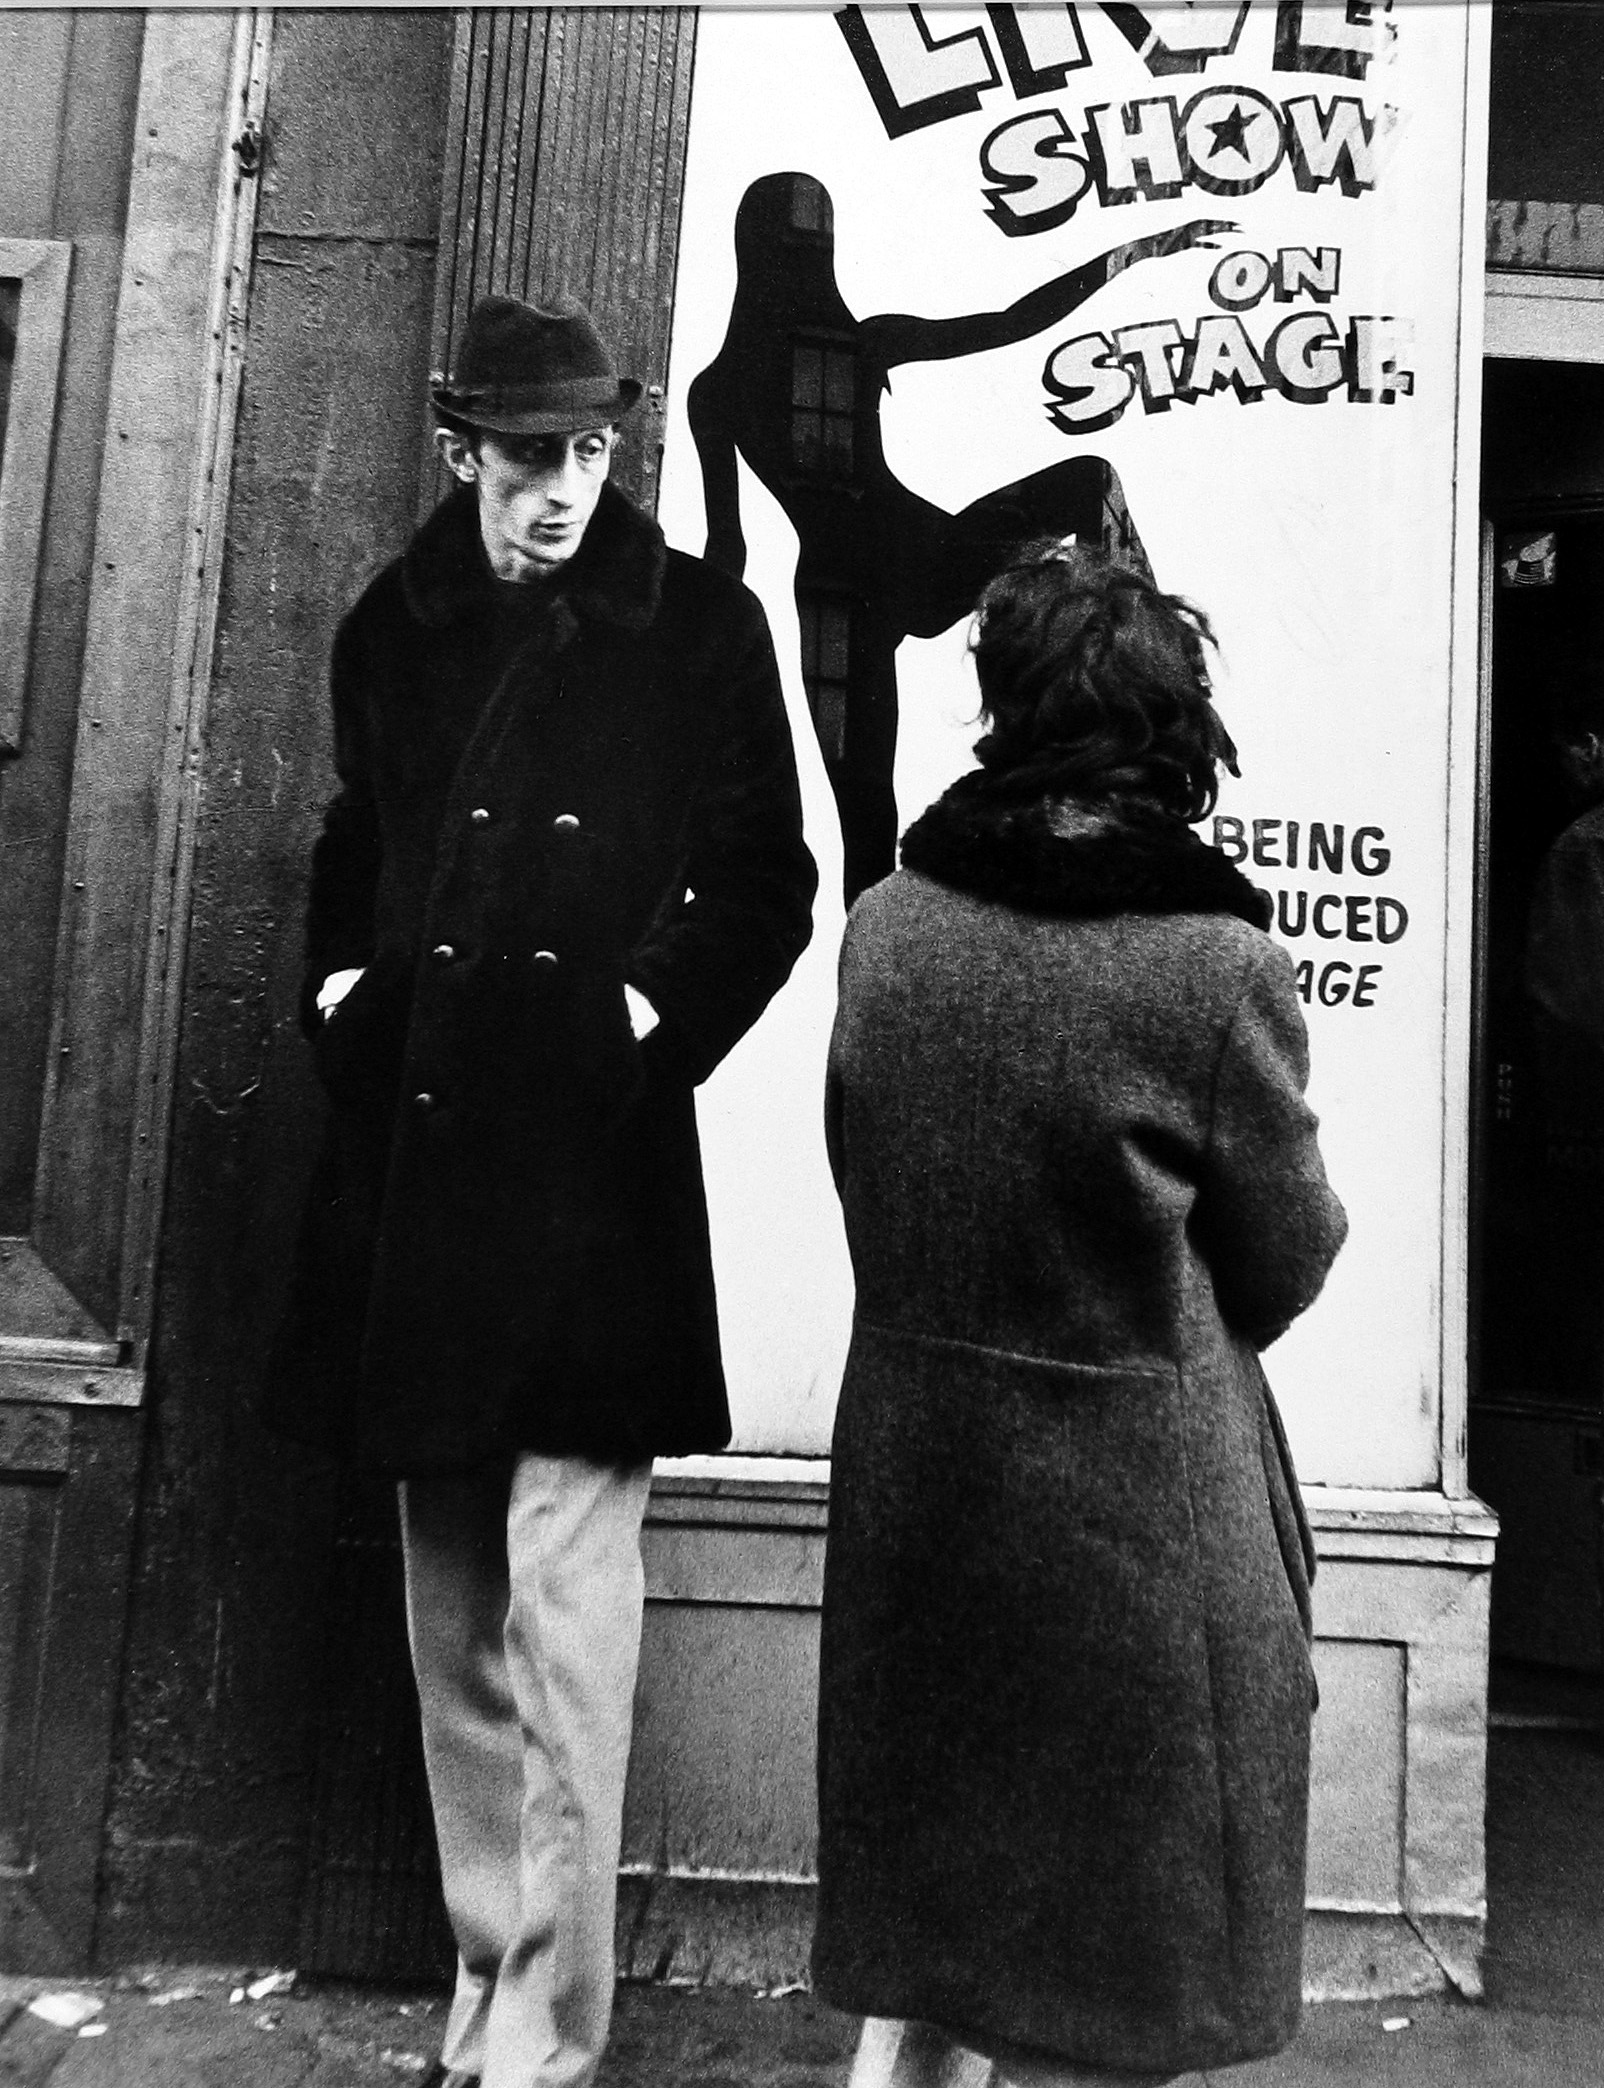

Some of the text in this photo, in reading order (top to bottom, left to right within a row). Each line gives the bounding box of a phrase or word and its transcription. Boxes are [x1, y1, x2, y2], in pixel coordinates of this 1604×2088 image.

[980, 85, 1399, 237] SHOW
[1208, 247, 1341, 311] ON
[1042, 312, 1415, 434] STAGE
[1213, 815, 1391, 876] BEING
